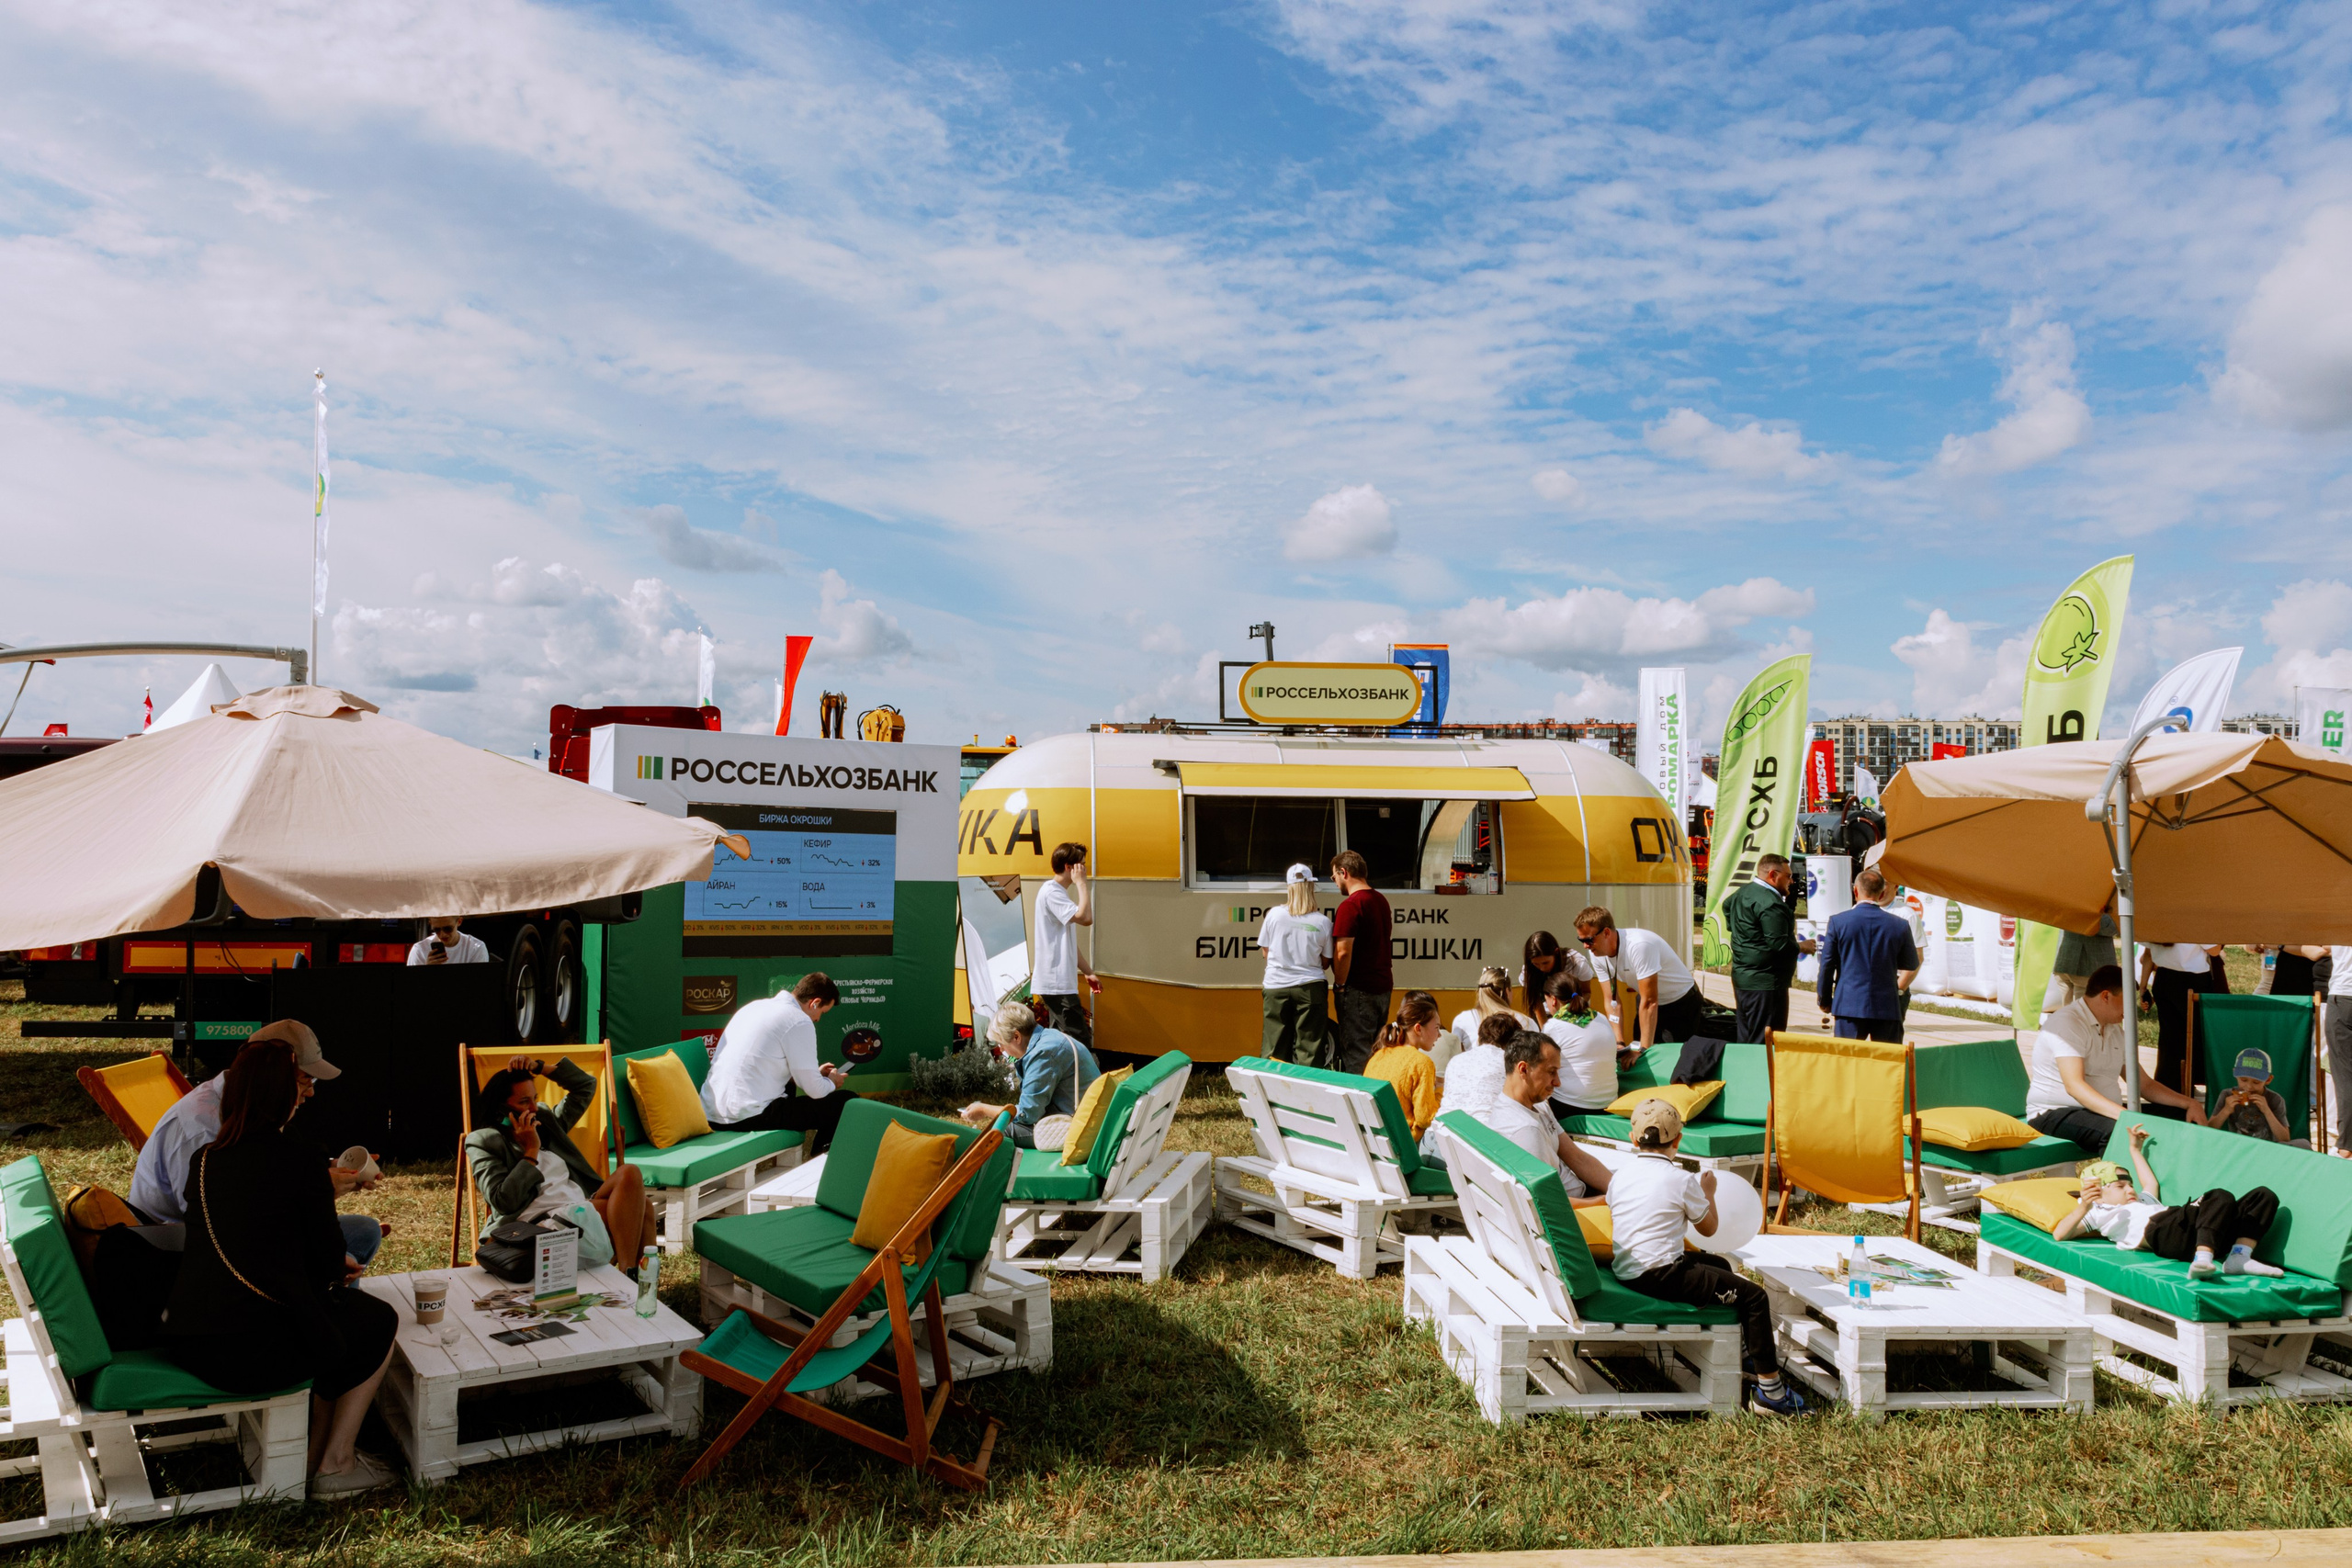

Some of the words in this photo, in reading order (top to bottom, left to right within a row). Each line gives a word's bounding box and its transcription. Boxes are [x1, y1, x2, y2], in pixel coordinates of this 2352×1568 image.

[1266, 686, 1409, 701] РОССЕЛЬХОЗБАНК
[2322, 709, 2345, 753] ER
[1666, 693, 1679, 809] РОМАРКА
[1658, 743, 1667, 790] ОВЫЙ
[671, 757, 939, 793] РОССЕЛЬХОЗБАНК
[1742, 756, 1778, 854] РСХБ
[759, 813, 789, 824] БИРЖА
[790, 813, 832, 826] ОКРОШКИ
[803, 840, 831, 848] КЕФИР
[776, 857, 791, 865] 50%
[867, 859, 881, 867] 32%
[707, 879, 736, 890] АЙРАН
[802, 882, 826, 892] ВОДА
[775, 900, 788, 908] 15%
[1195, 936, 1261, 959] БИР
[1390, 938, 1482, 960] ОШКИ
[685, 988, 731, 1000] РОСКАР
[206, 1025, 253, 1036] 975800
